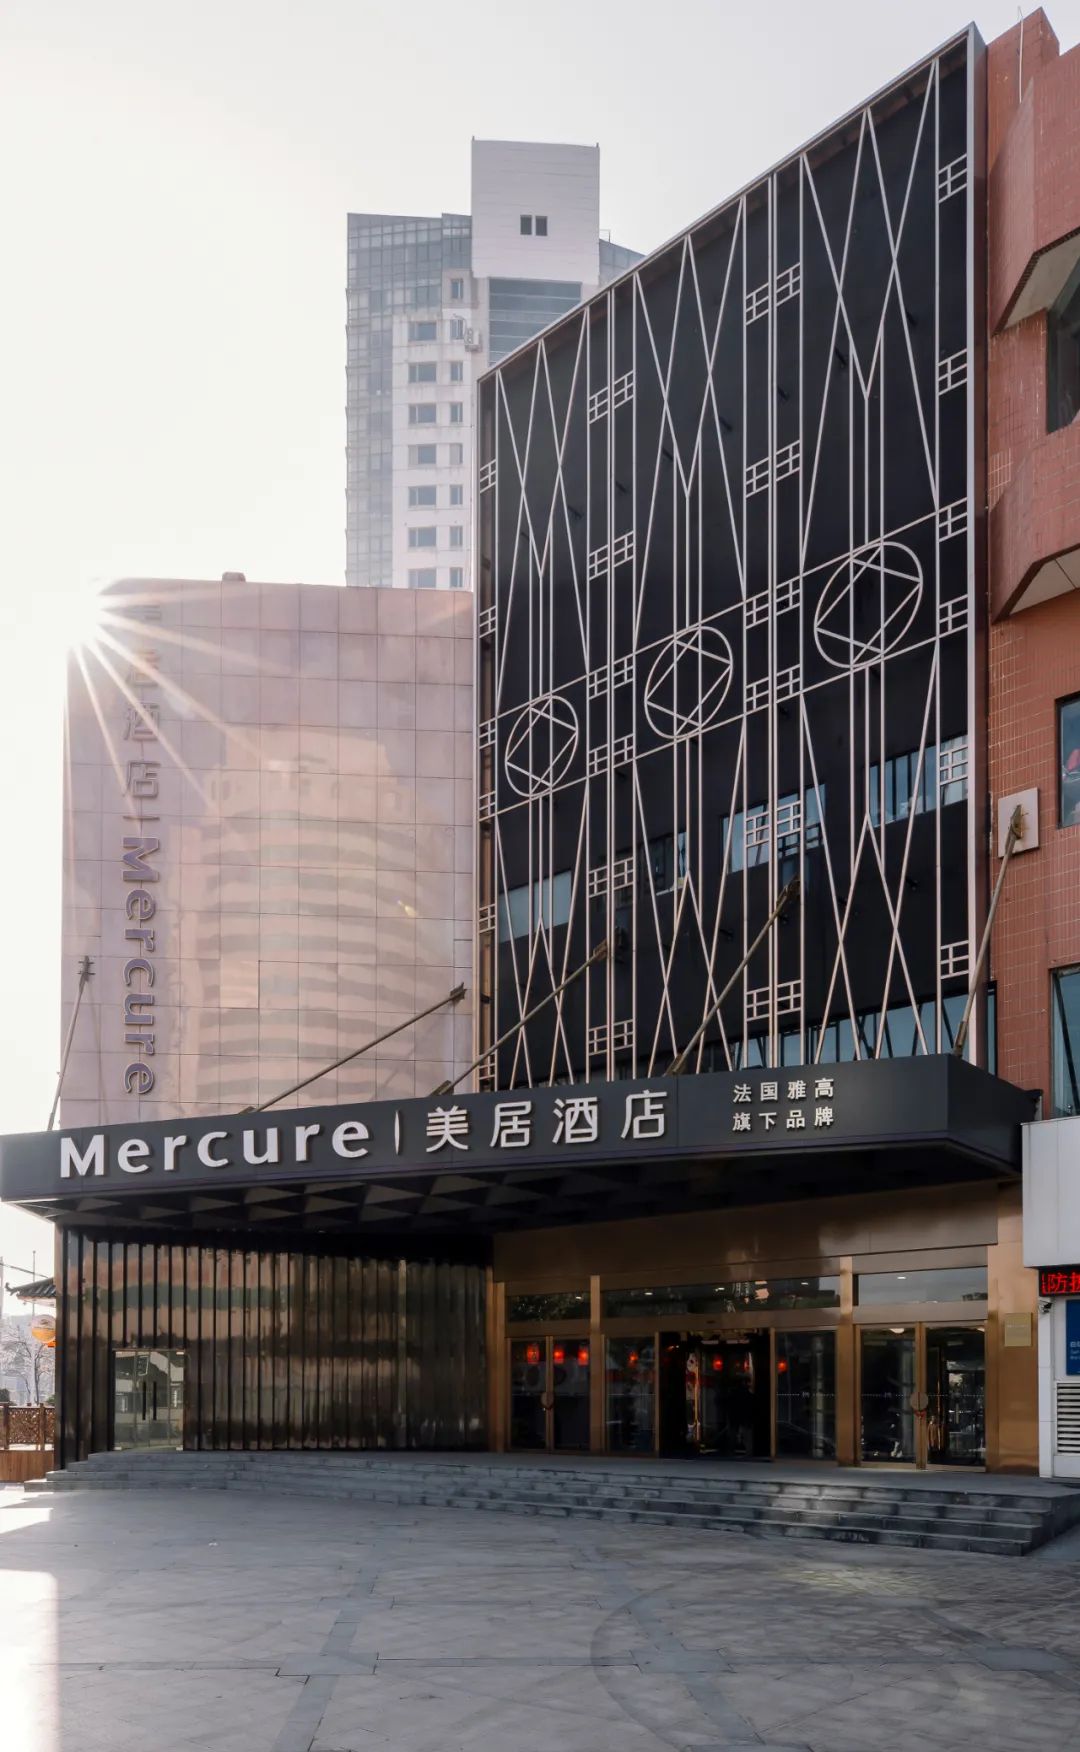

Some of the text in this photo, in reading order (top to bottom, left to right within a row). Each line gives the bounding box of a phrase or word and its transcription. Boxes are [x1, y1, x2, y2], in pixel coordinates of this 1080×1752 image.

[122, 837, 159, 1094] Mercure
[732, 1077, 834, 1103] 法国雅高
[426, 1090, 667, 1152] 美居酒店
[732, 1106, 834, 1132] 旗下品牌
[60, 1121, 370, 1178] Mercure
